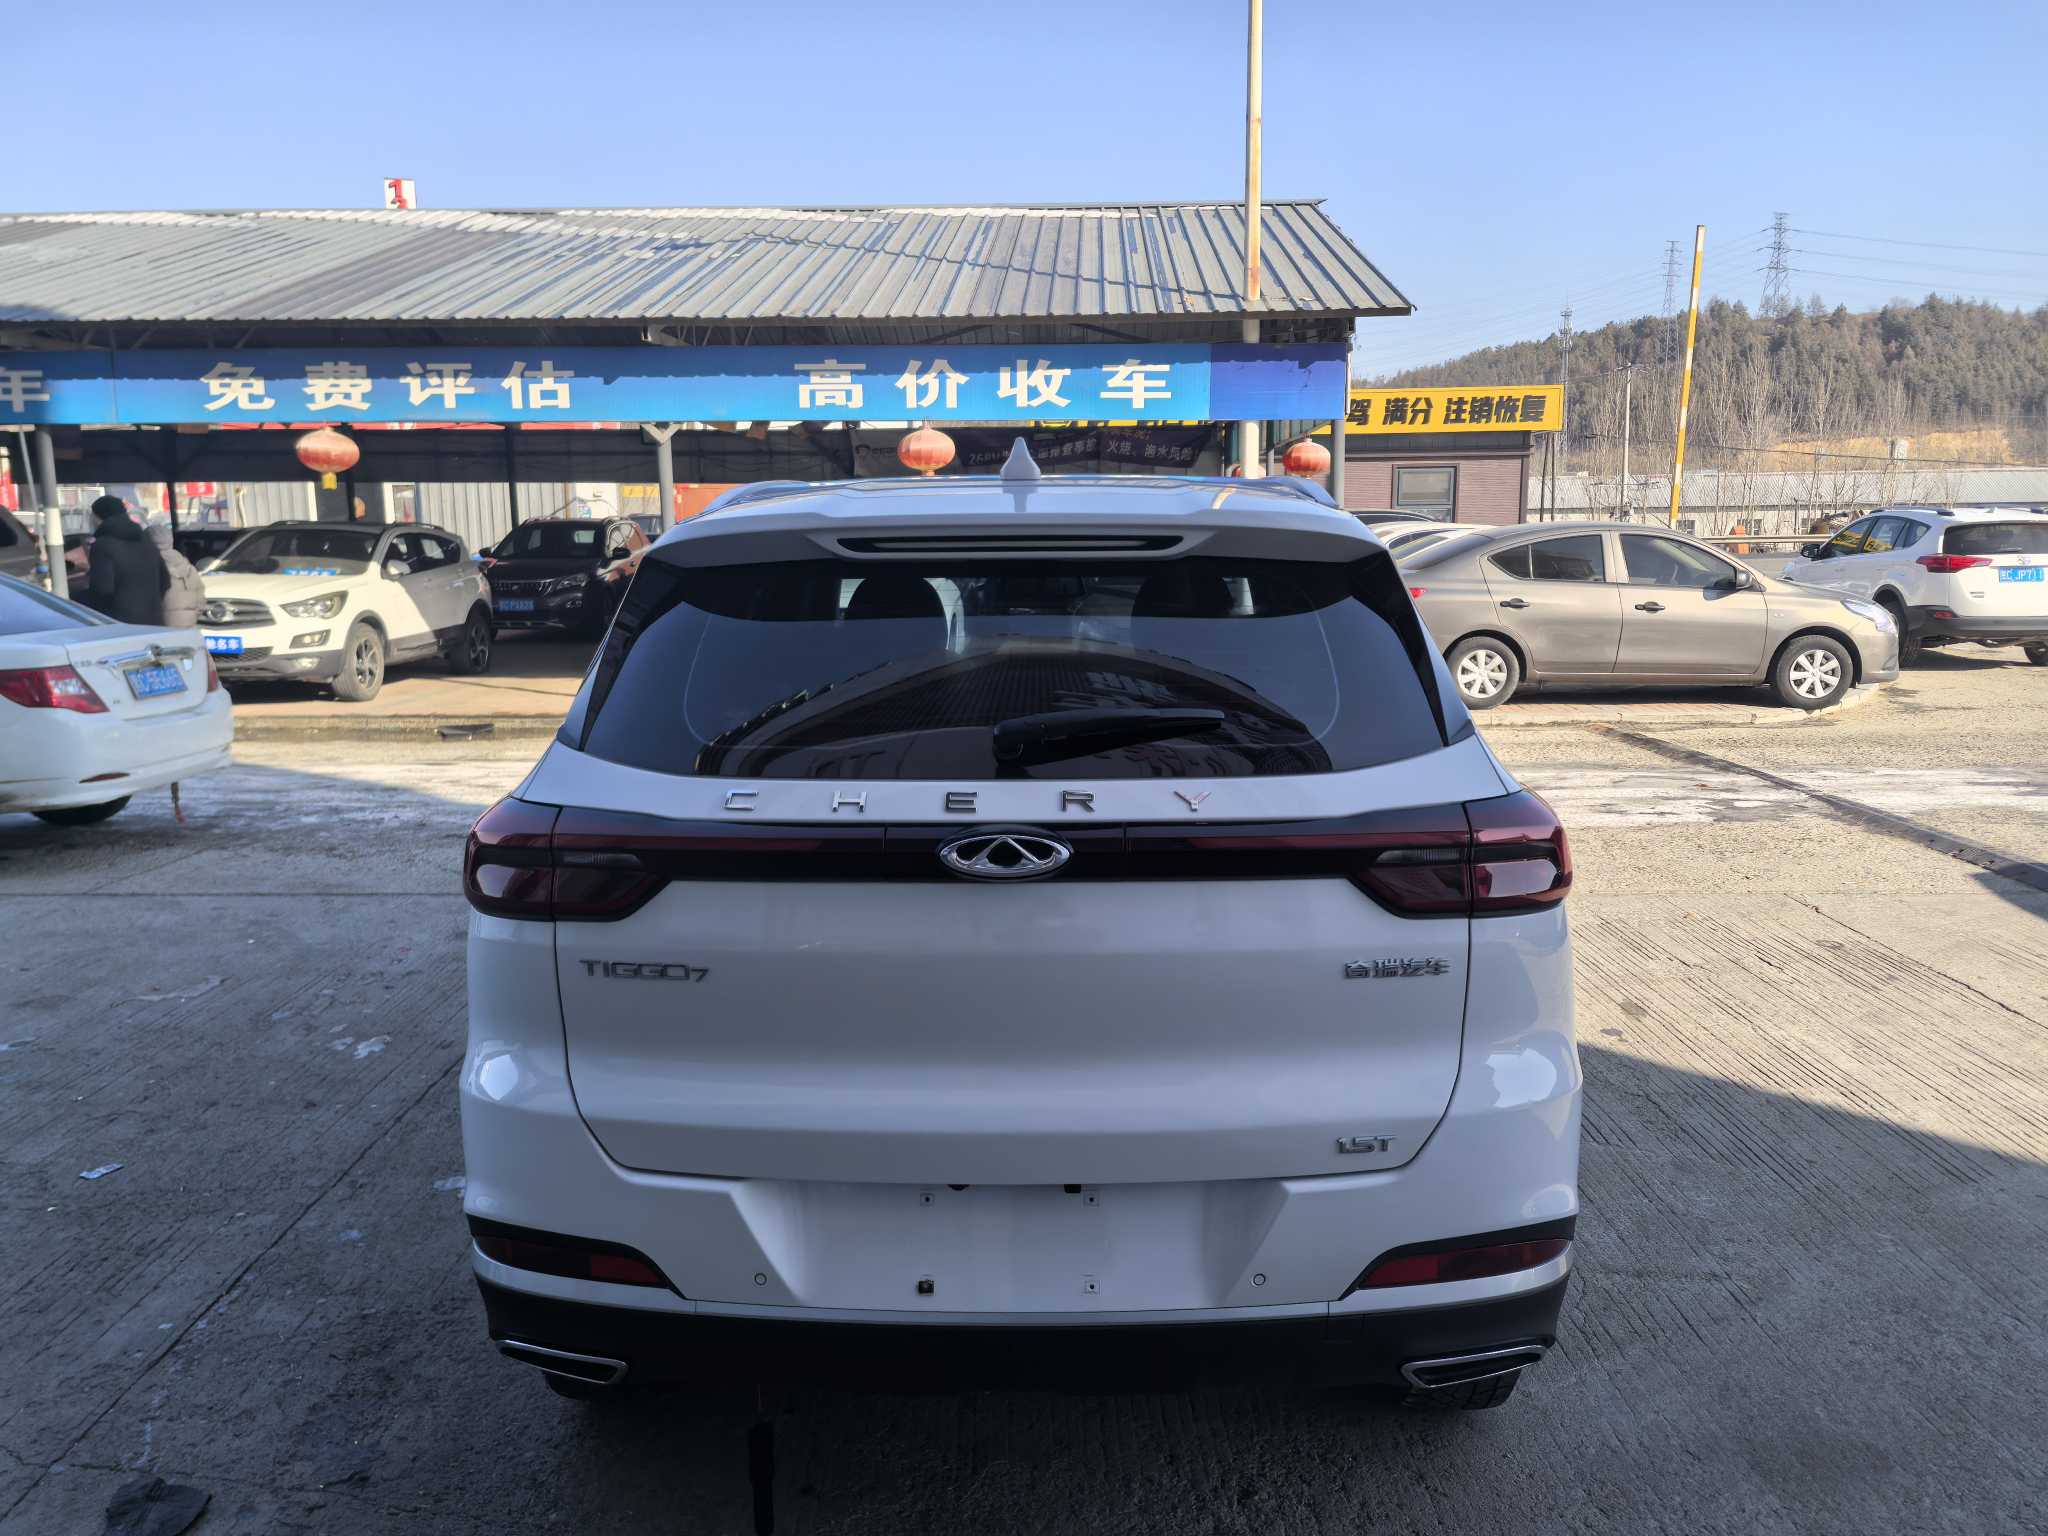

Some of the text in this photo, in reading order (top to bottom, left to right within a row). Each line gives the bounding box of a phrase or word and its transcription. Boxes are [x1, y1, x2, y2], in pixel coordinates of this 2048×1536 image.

[0, 359, 1172, 413] 年 免费评估 高价收车
[1382, 396, 1433, 425] 满分
[1443, 394, 1546, 425] 注销恢复
[722, 789, 1212, 813] CHERY
[1344, 956, 1451, 979] 奇瑞汽车
